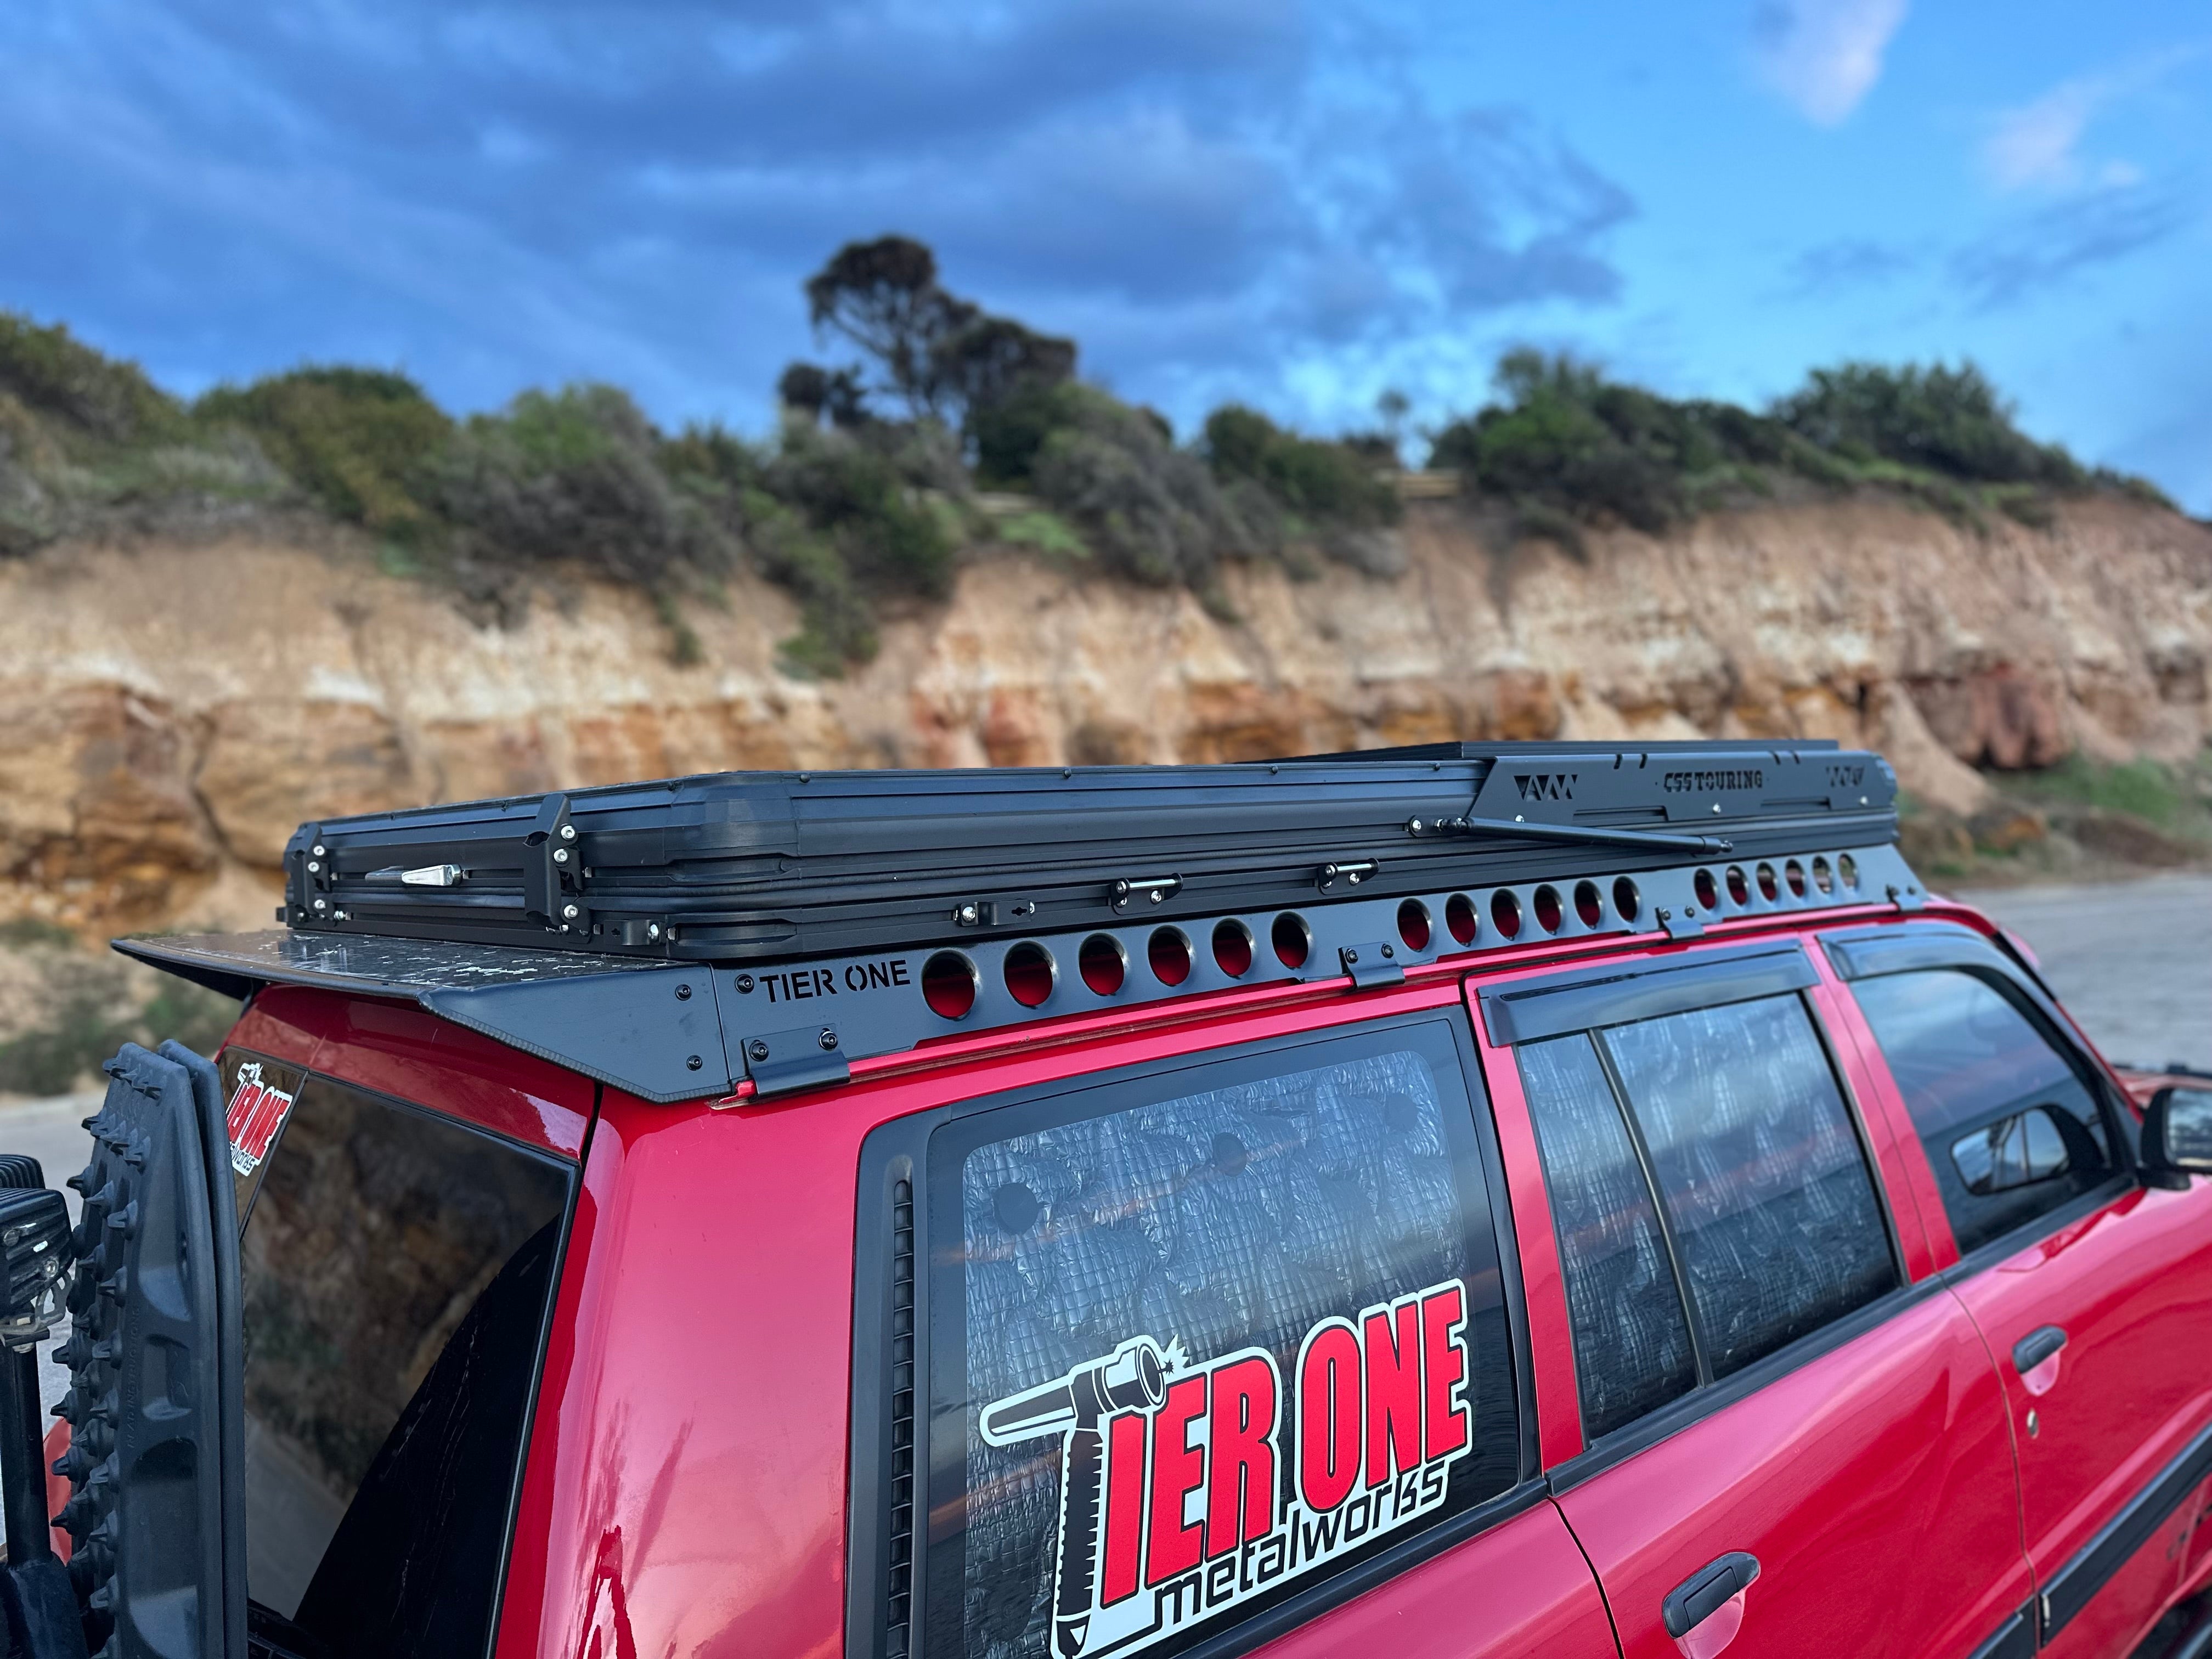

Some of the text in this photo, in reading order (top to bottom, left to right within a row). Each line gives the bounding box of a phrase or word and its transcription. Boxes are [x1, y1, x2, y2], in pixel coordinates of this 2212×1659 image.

[1694, 770, 1763, 791] TOURING
[759, 959, 911, 1003] TIER ONE
[239, 1091, 290, 1160] ONE
[1301, 1285, 1468, 1513] ONE
[1152, 1460, 1446, 1630] metalworks
